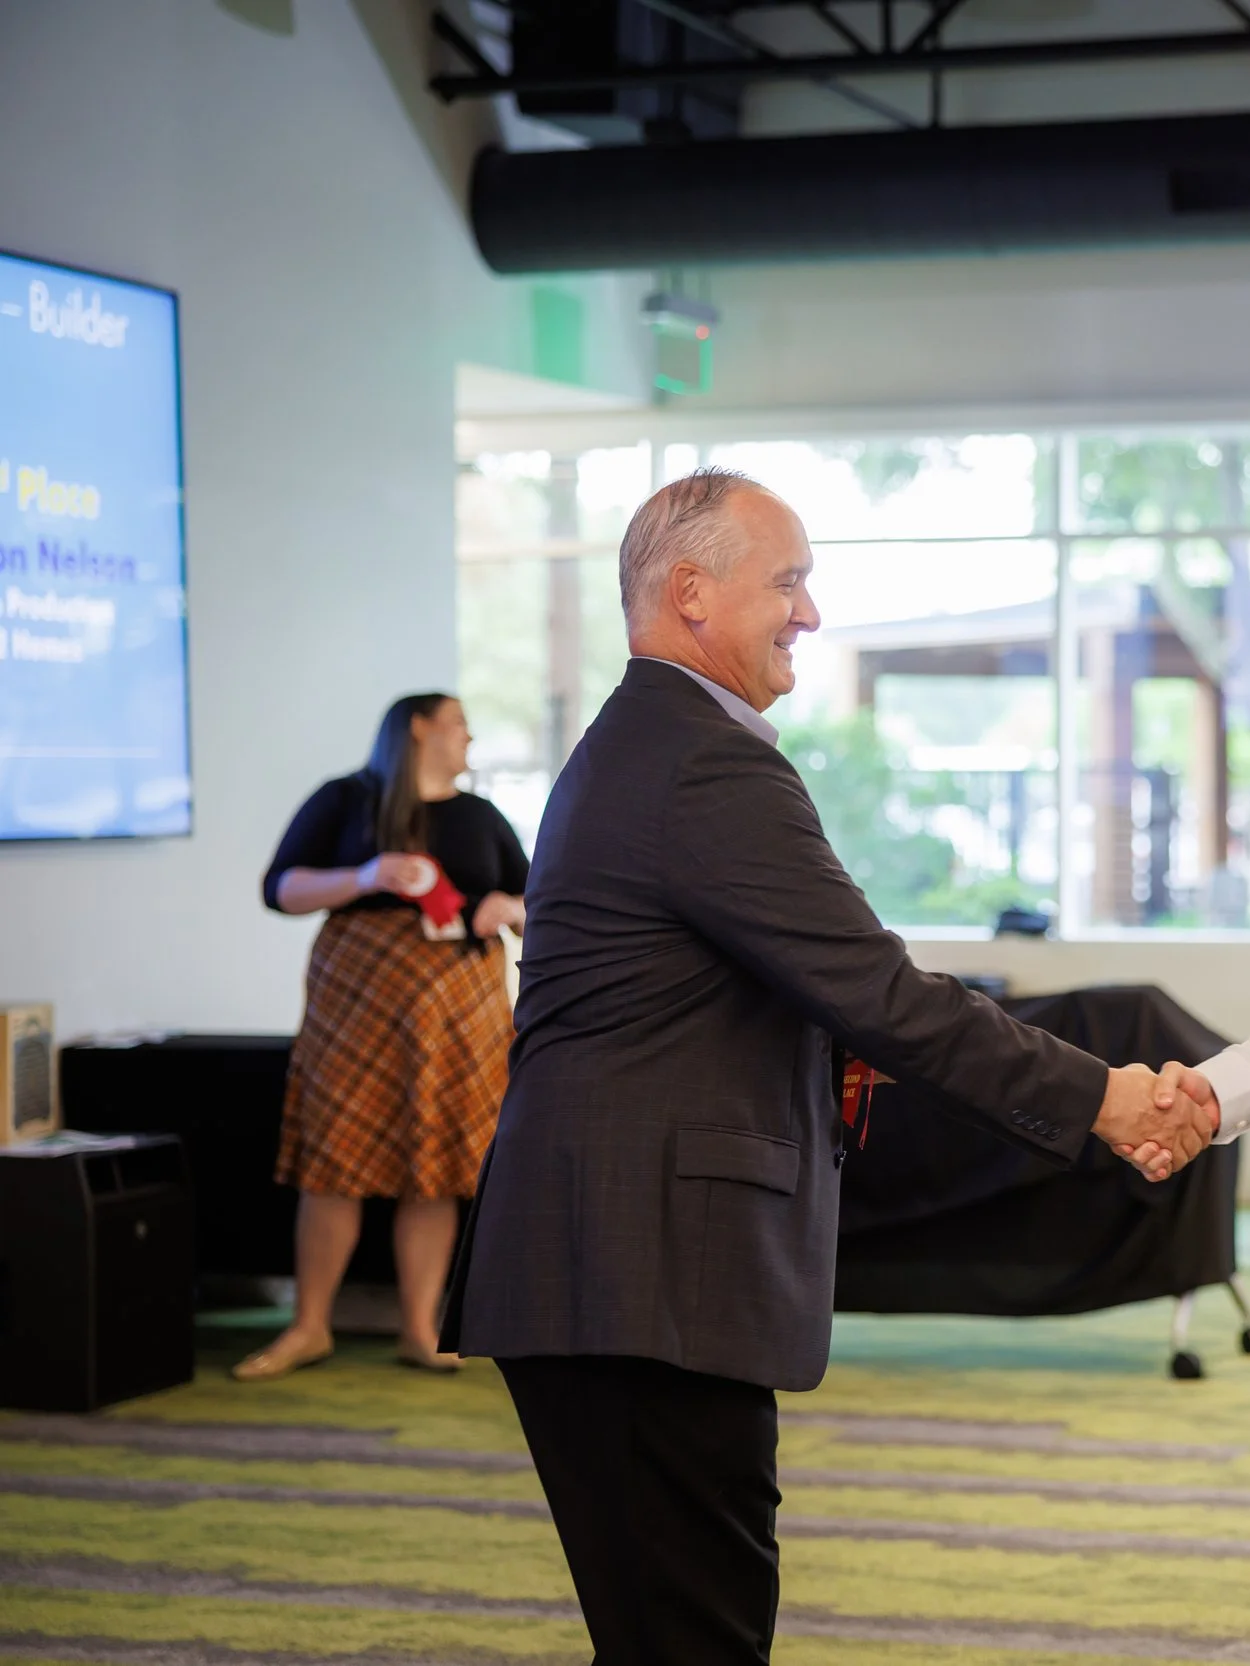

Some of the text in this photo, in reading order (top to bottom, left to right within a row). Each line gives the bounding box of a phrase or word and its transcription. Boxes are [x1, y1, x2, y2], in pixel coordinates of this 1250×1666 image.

[29, 280, 130, 348] Builder
[17, 464, 101, 521] Place
[843, 1088, 856, 1098] LACE
